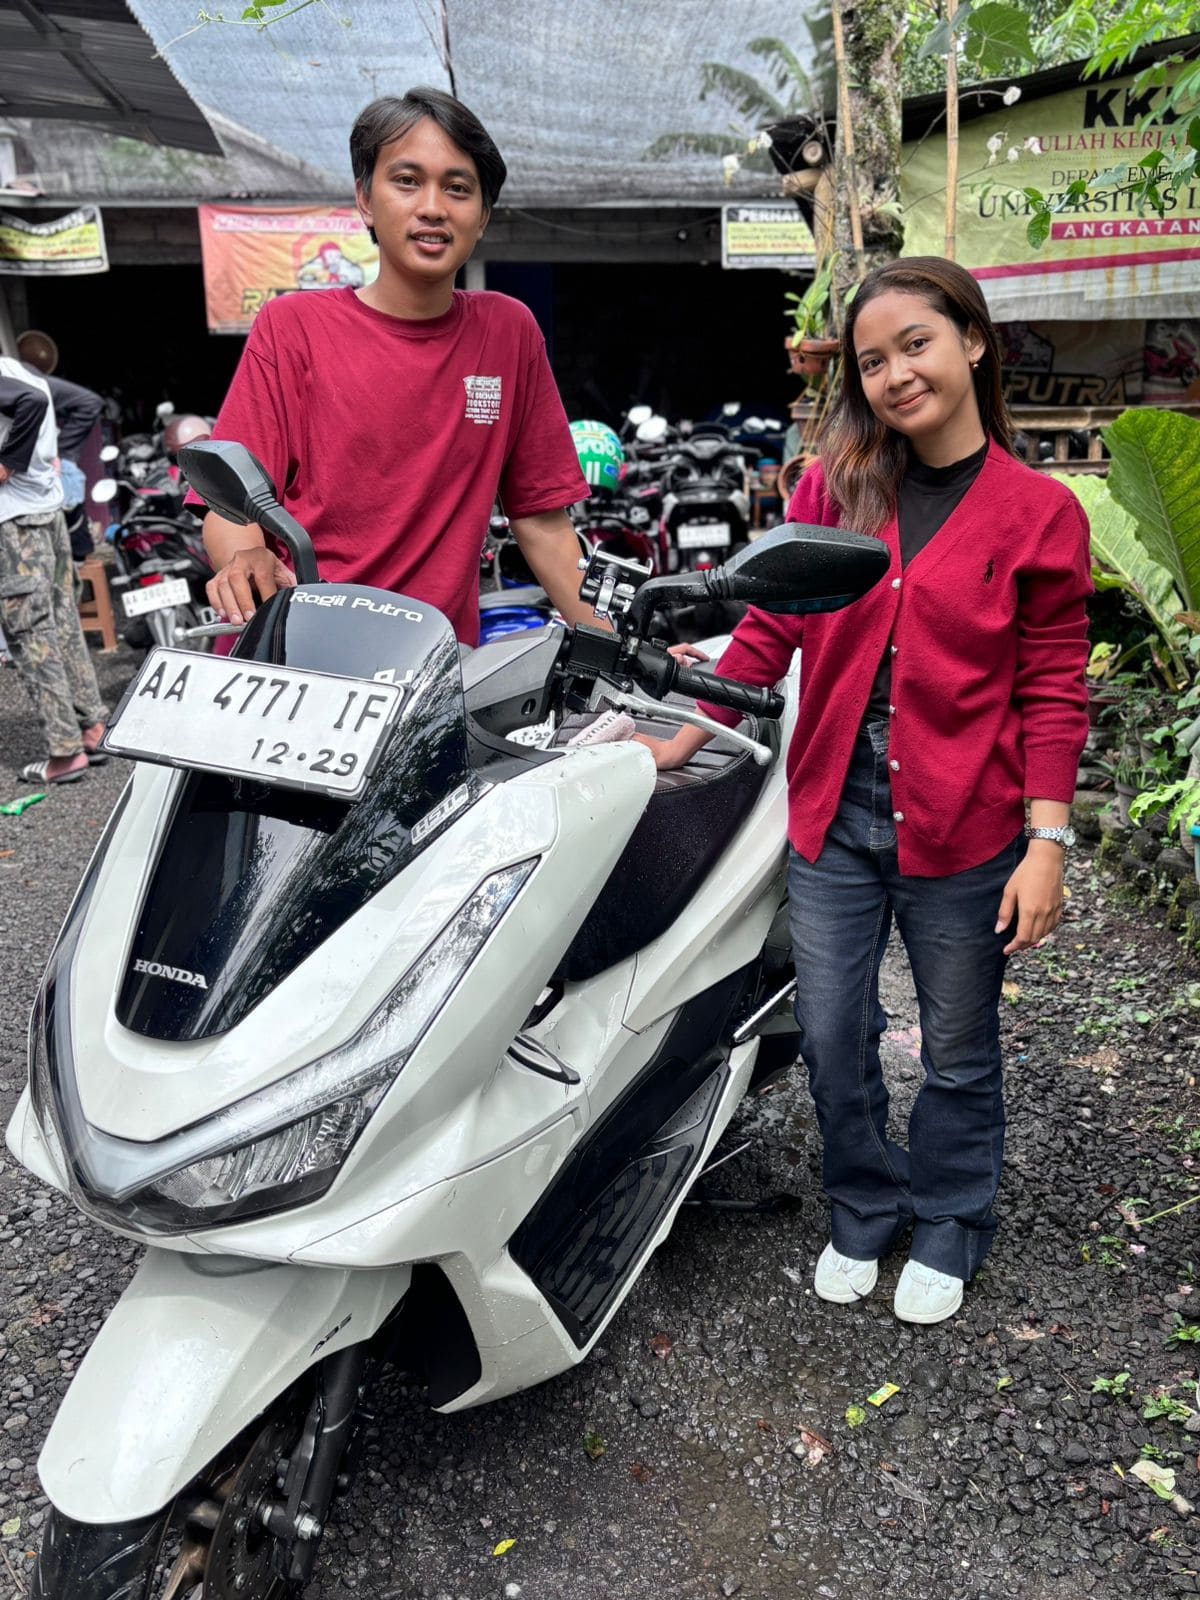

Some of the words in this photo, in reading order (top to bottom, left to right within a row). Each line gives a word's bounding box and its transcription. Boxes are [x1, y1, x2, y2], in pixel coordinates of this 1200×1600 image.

[1024, 133, 1105, 151] ULIAH
[1064, 220, 1200, 238] ANGKATAN
[1004, 375, 1126, 405] PUTRA
[289, 591, 347, 607] Ragil
[351, 597, 424, 623] Putra
[139, 661, 191, 701] AA
[213, 672, 308, 720] 4771
[333, 691, 388, 732] IF
[133, 959, 208, 989] HONDA
